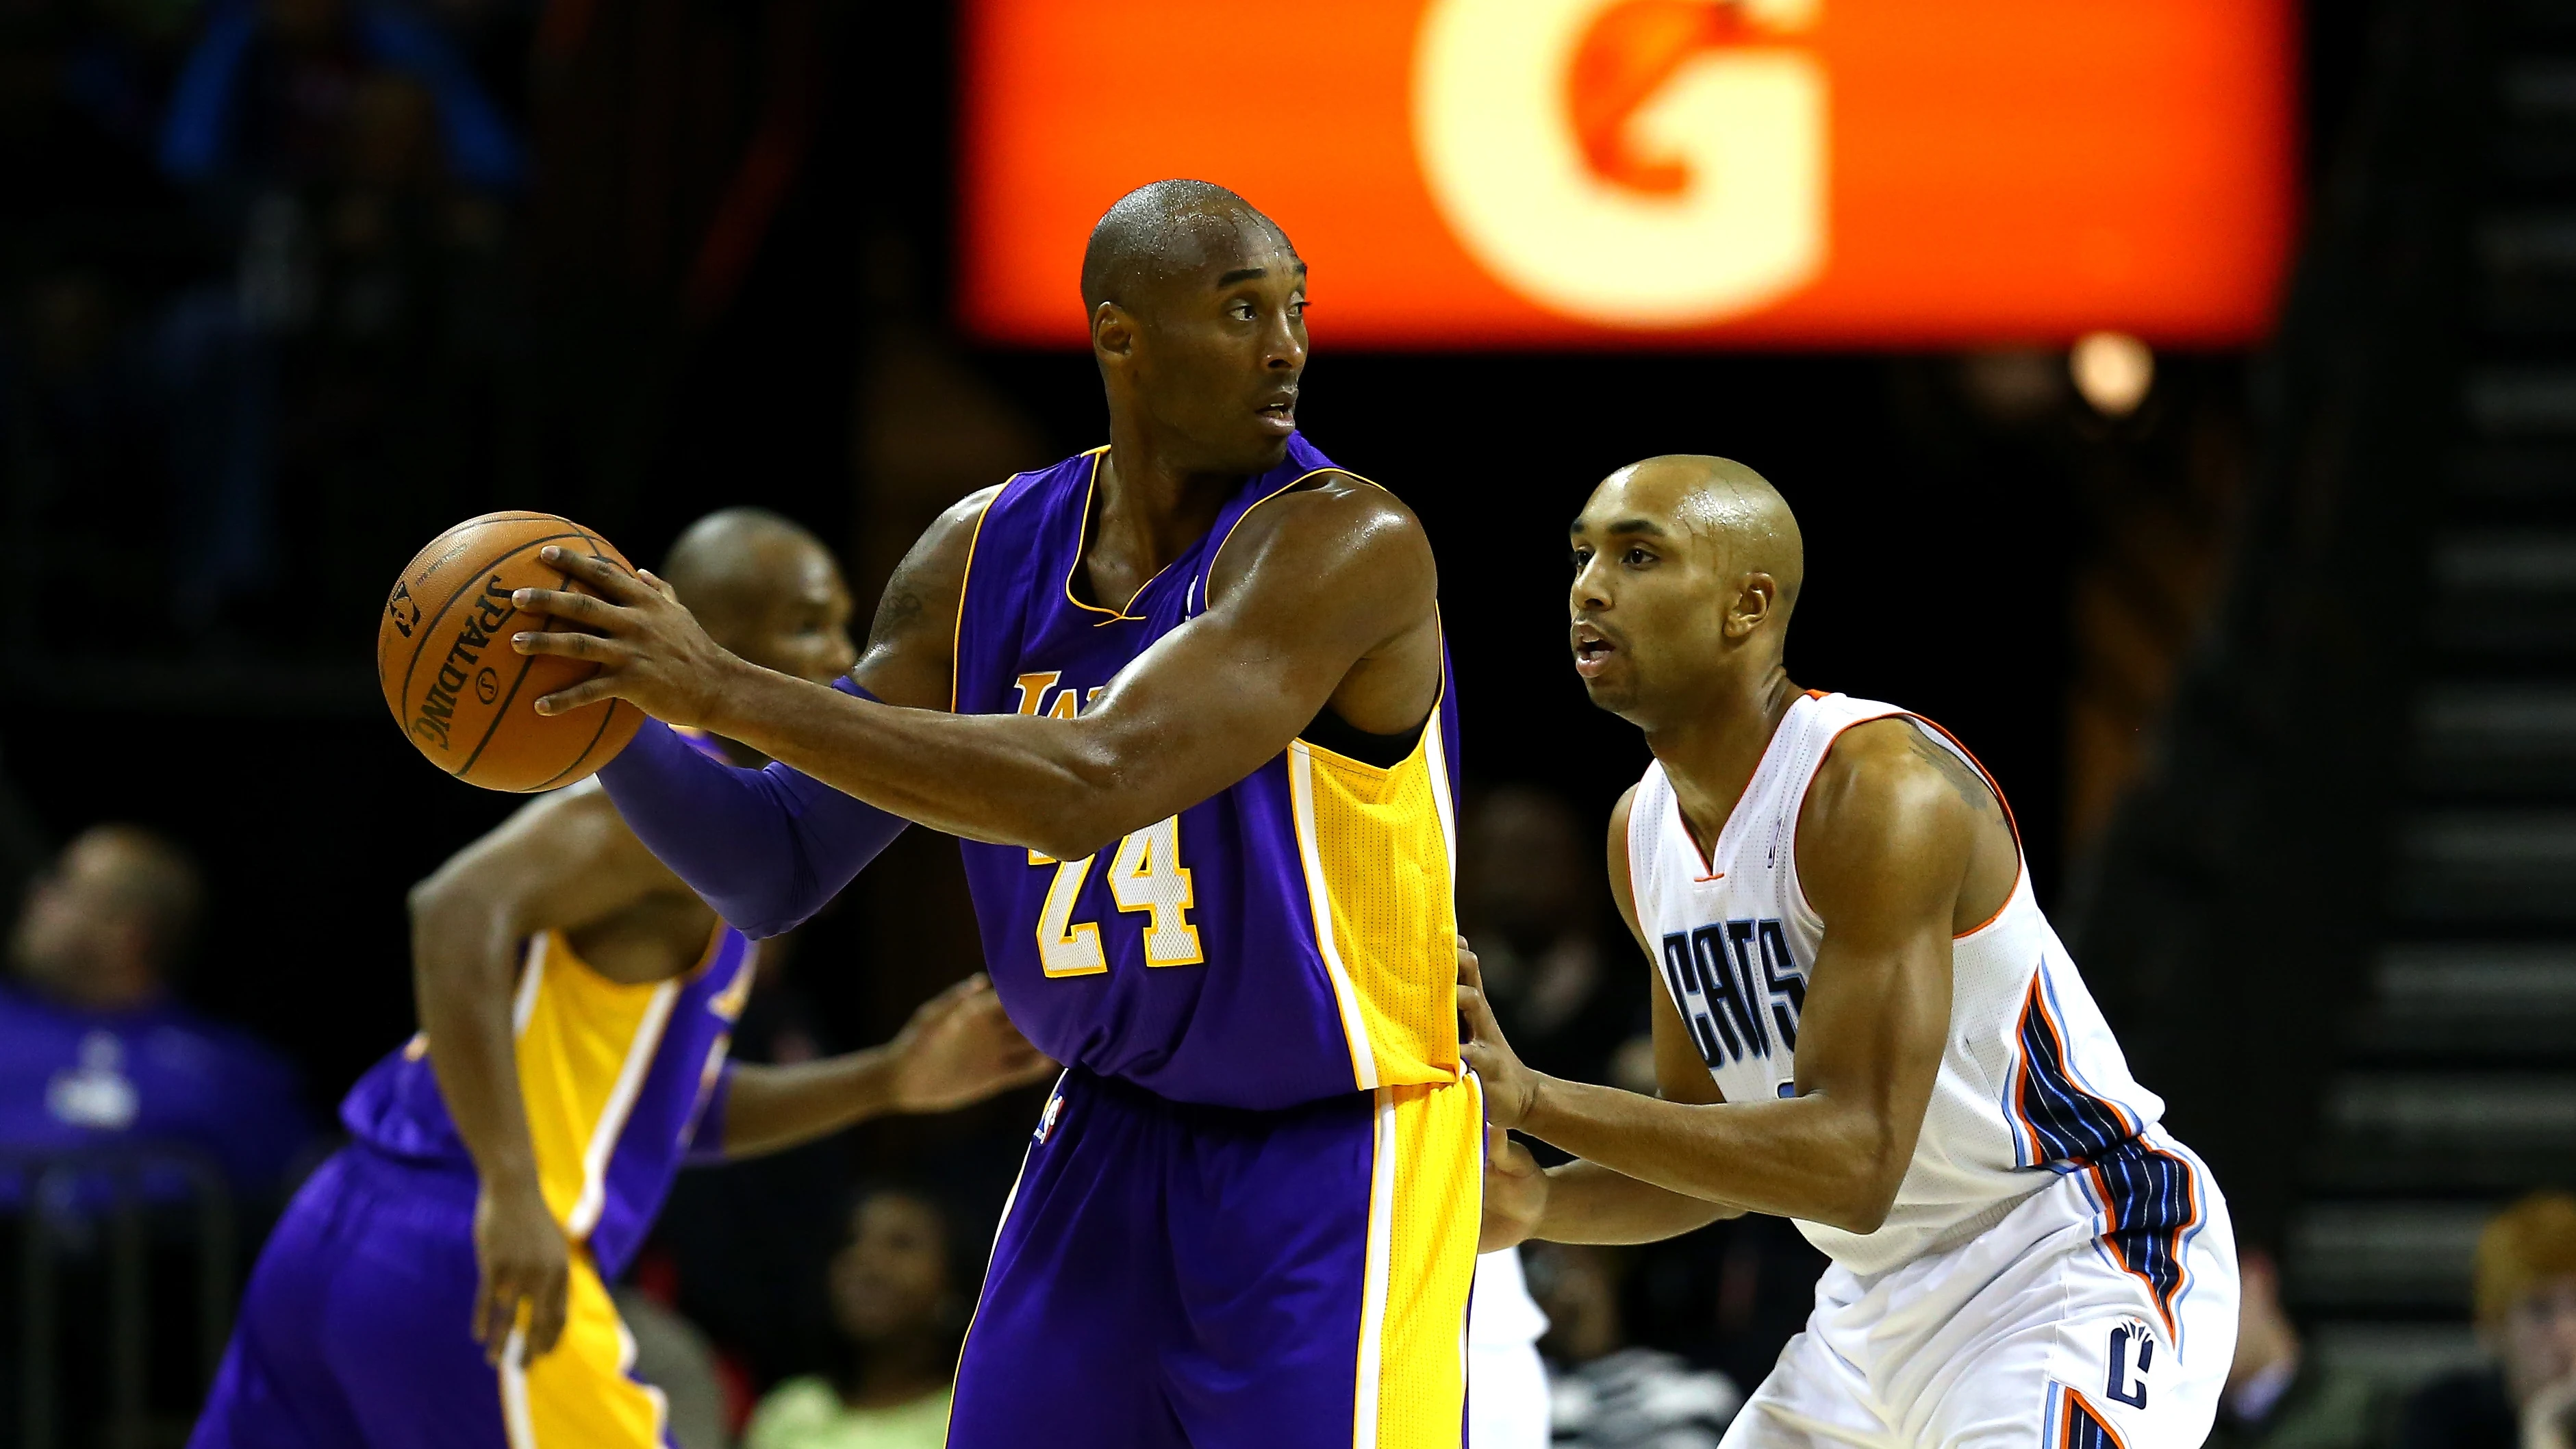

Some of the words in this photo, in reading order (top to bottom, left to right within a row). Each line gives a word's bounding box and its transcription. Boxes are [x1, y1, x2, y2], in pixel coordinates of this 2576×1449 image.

[1413, 0, 1829, 325] G
[413, 575, 516, 751] SPALDING
[1028, 814, 1204, 978] 24
[1663, 918, 1808, 1070] CATS
